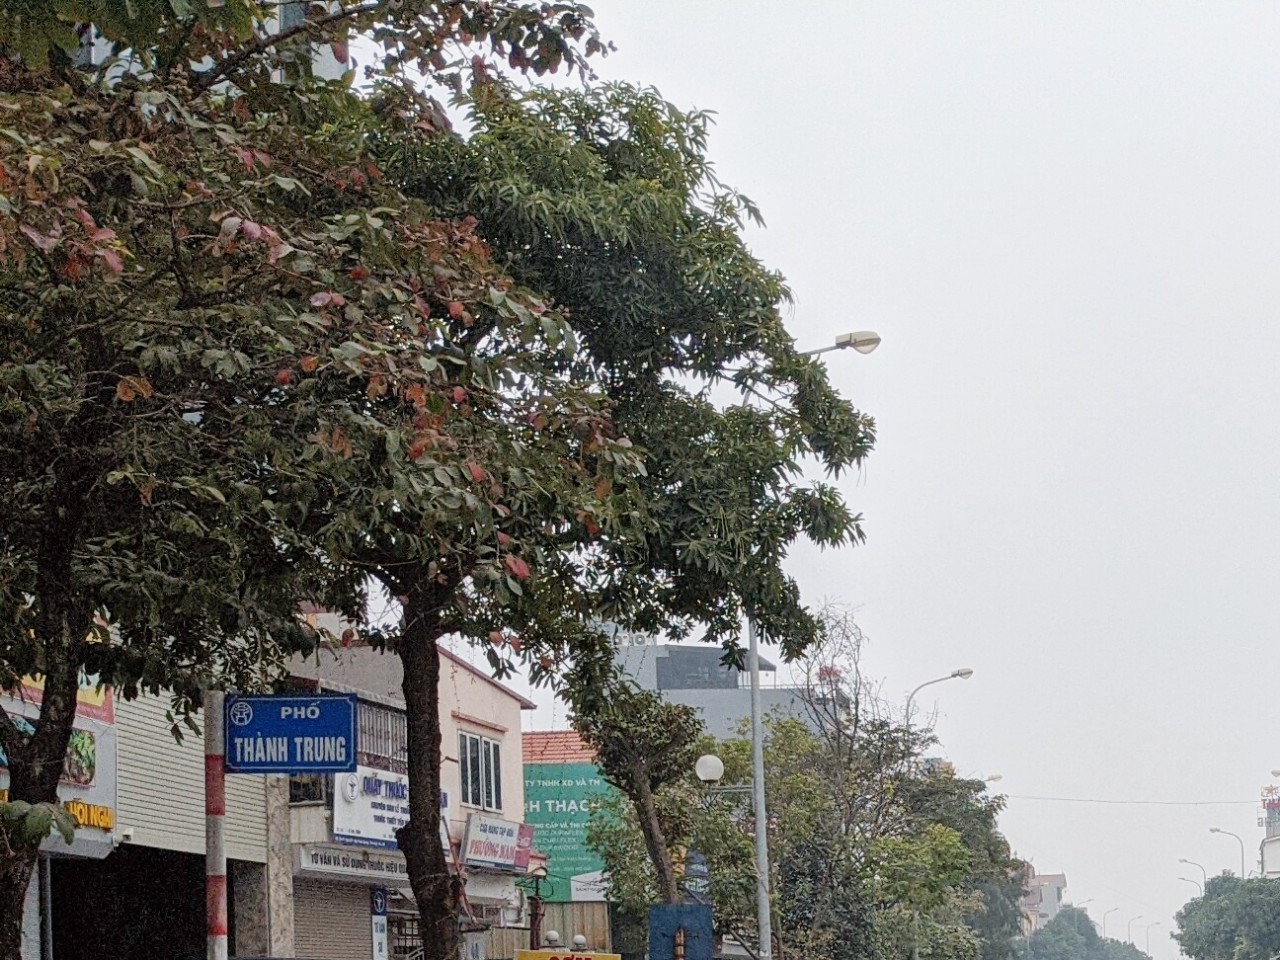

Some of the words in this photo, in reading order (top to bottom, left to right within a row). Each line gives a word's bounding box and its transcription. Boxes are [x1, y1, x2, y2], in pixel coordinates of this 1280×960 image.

[280, 700, 320, 719] PHỐ
[234, 731, 288, 762] THÀNH
[294, 736, 346, 762] TRUNG
[576, 778, 587, 786] VÀ
